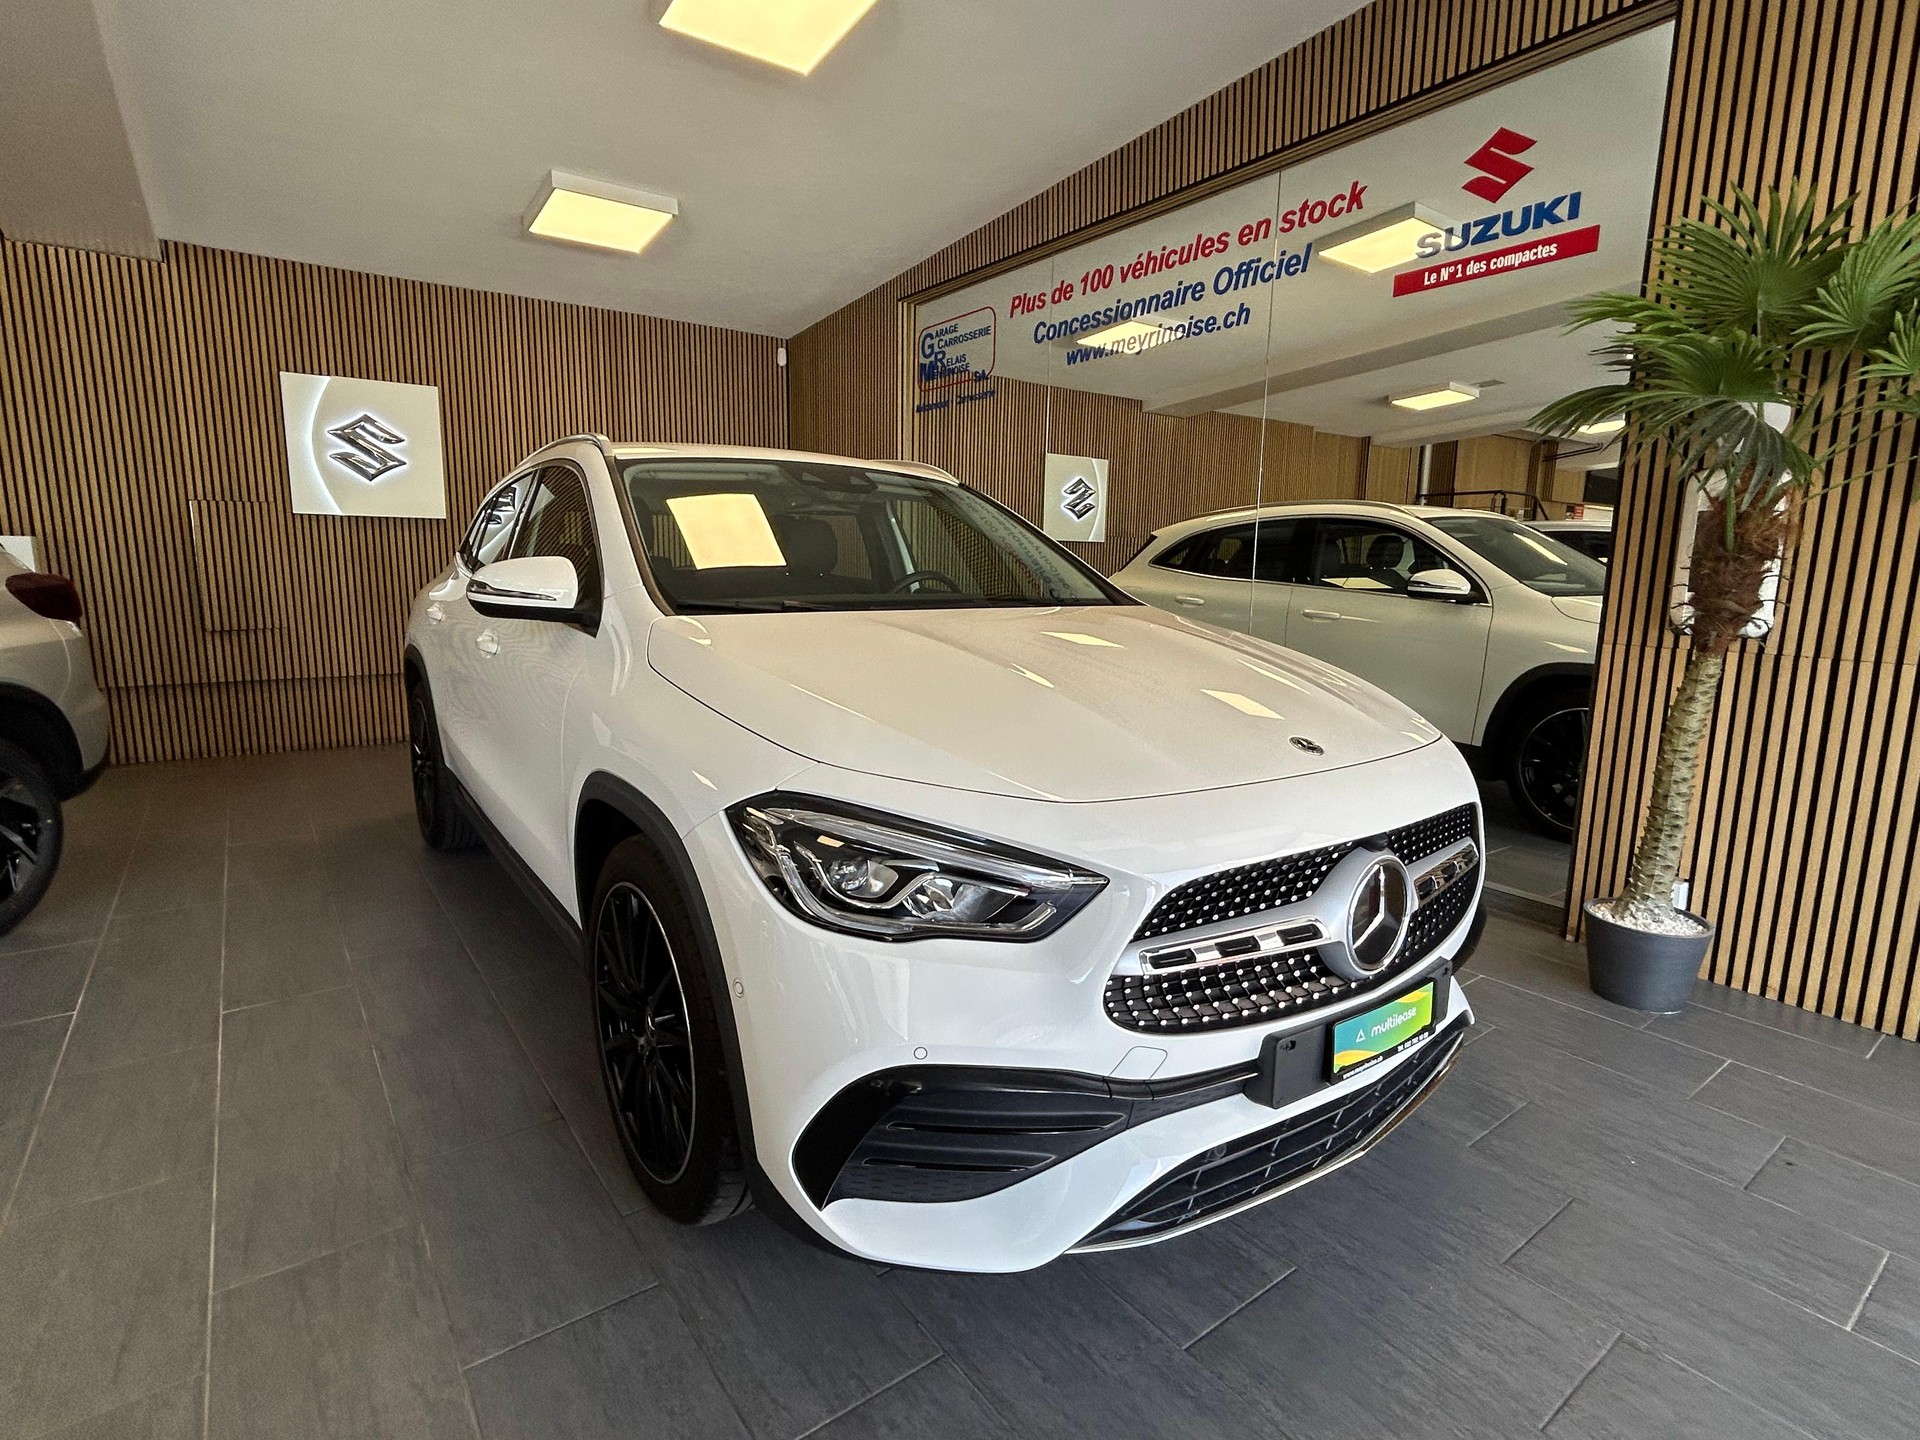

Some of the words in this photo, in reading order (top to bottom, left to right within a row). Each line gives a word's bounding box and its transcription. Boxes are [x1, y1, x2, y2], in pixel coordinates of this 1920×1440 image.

[1010, 292, 1047, 318] Plus
[1051, 280, 1074, 304] de
[1081, 264, 1114, 295] 100
[1120, 231, 1231, 283] véhicules
[1238, 217, 1271, 246] en
[1279, 181, 1368, 234] stock
[1416, 191, 1582, 259] SUZUKI
[1034, 280, 1205, 344] Concessionnaire
[1213, 242, 1313, 295] Officiel
[1424, 271, 1437, 286] Le
[1466, 257, 1487, 275] des
[1490, 243, 1558, 270] compactes
[937, 325, 992, 350] CARROSSERIE
[1067, 303, 1250, 366] www.meyrinoise.ch
[1370, 1006, 1417, 1038] multilease
